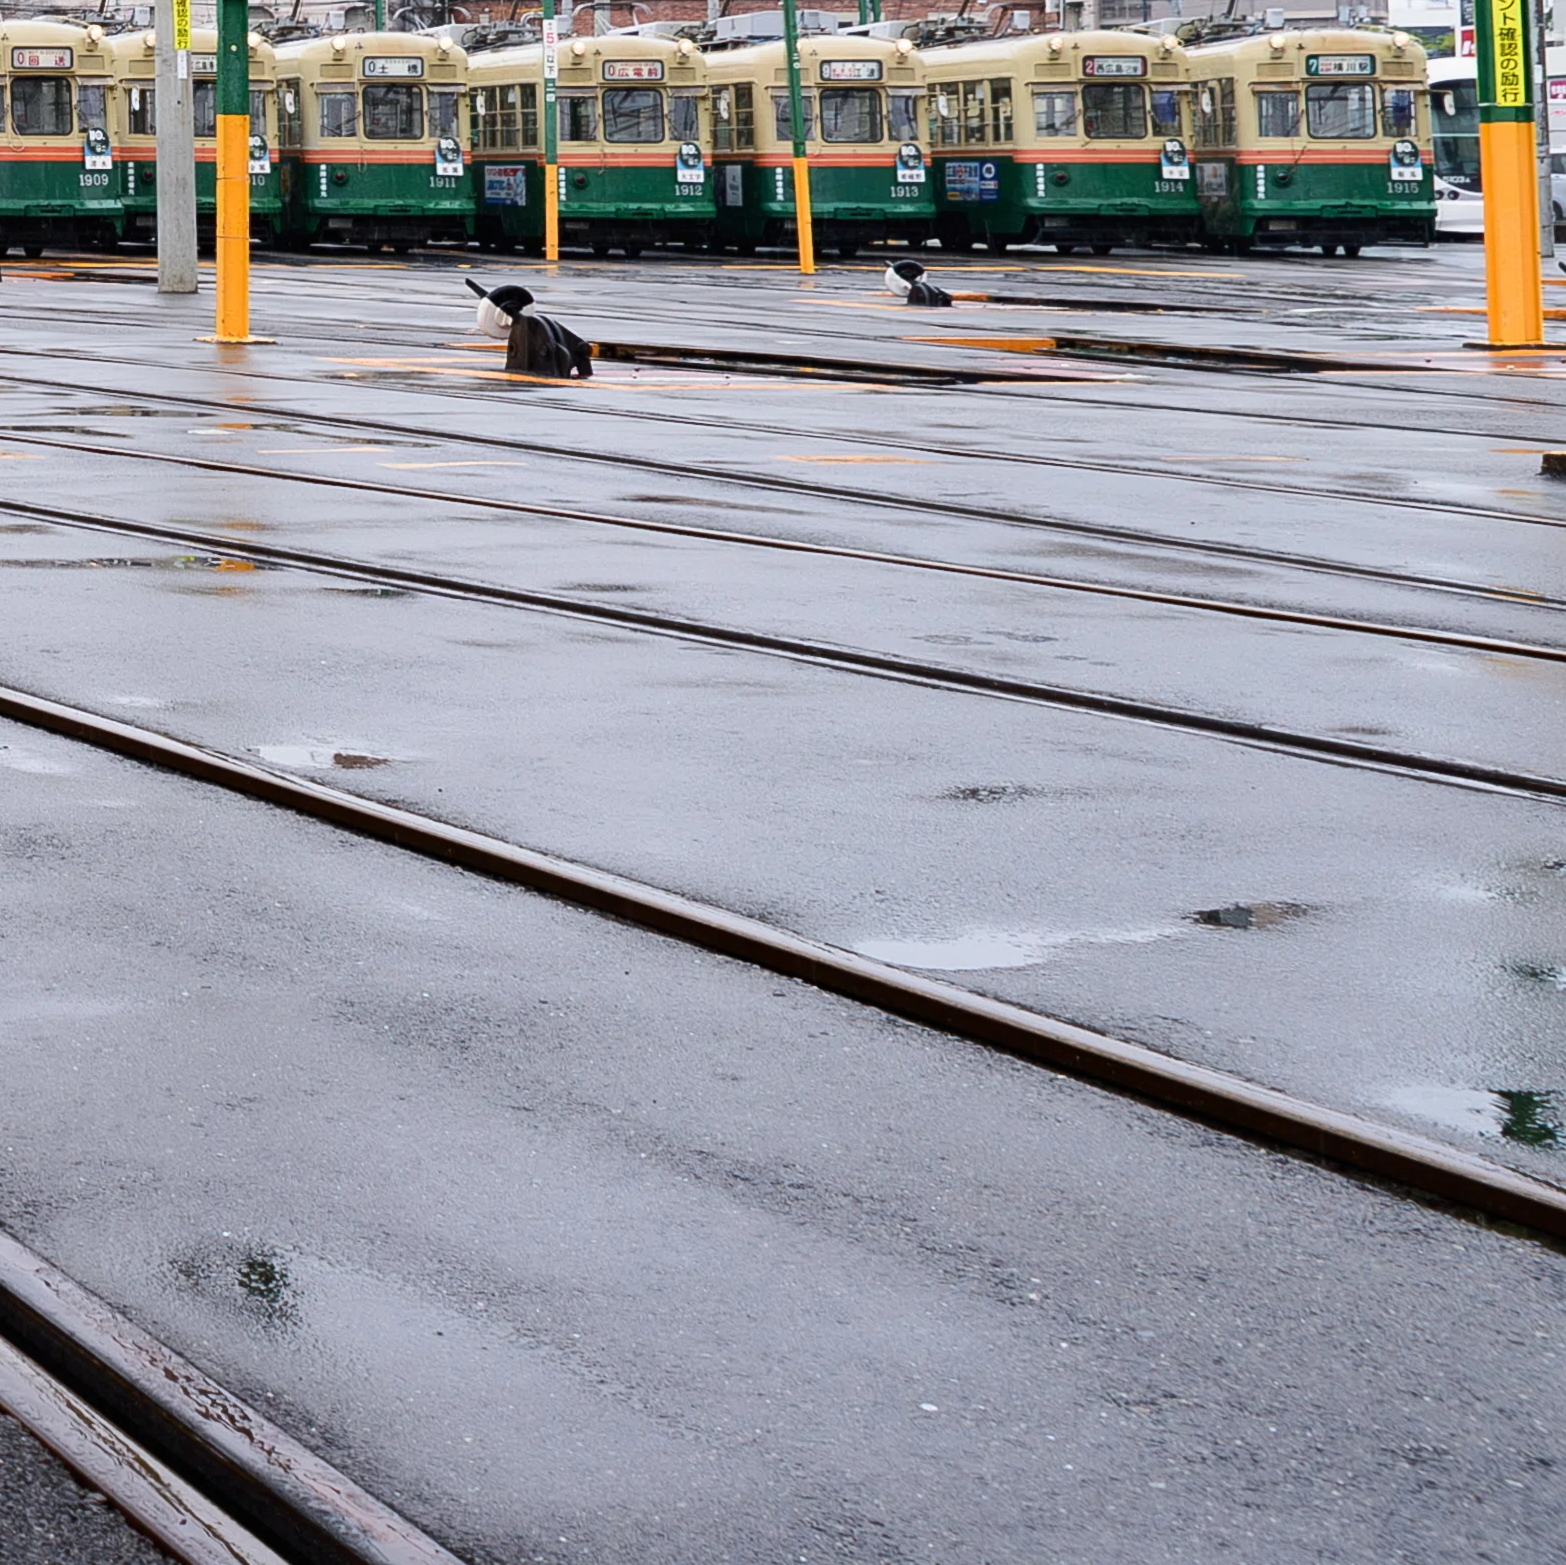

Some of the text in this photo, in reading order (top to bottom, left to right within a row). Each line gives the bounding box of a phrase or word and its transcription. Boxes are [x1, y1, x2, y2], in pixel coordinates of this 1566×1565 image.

[1085, 61, 1093, 74] 2
[79, 174, 109, 187] 1909
[429, 176, 457, 188] 1911
[675, 185, 703, 196] 1912
[890, 185, 919, 198] 1913
[1154, 181, 1184, 193] 1914
[1387, 182, 1419, 194] 1915
